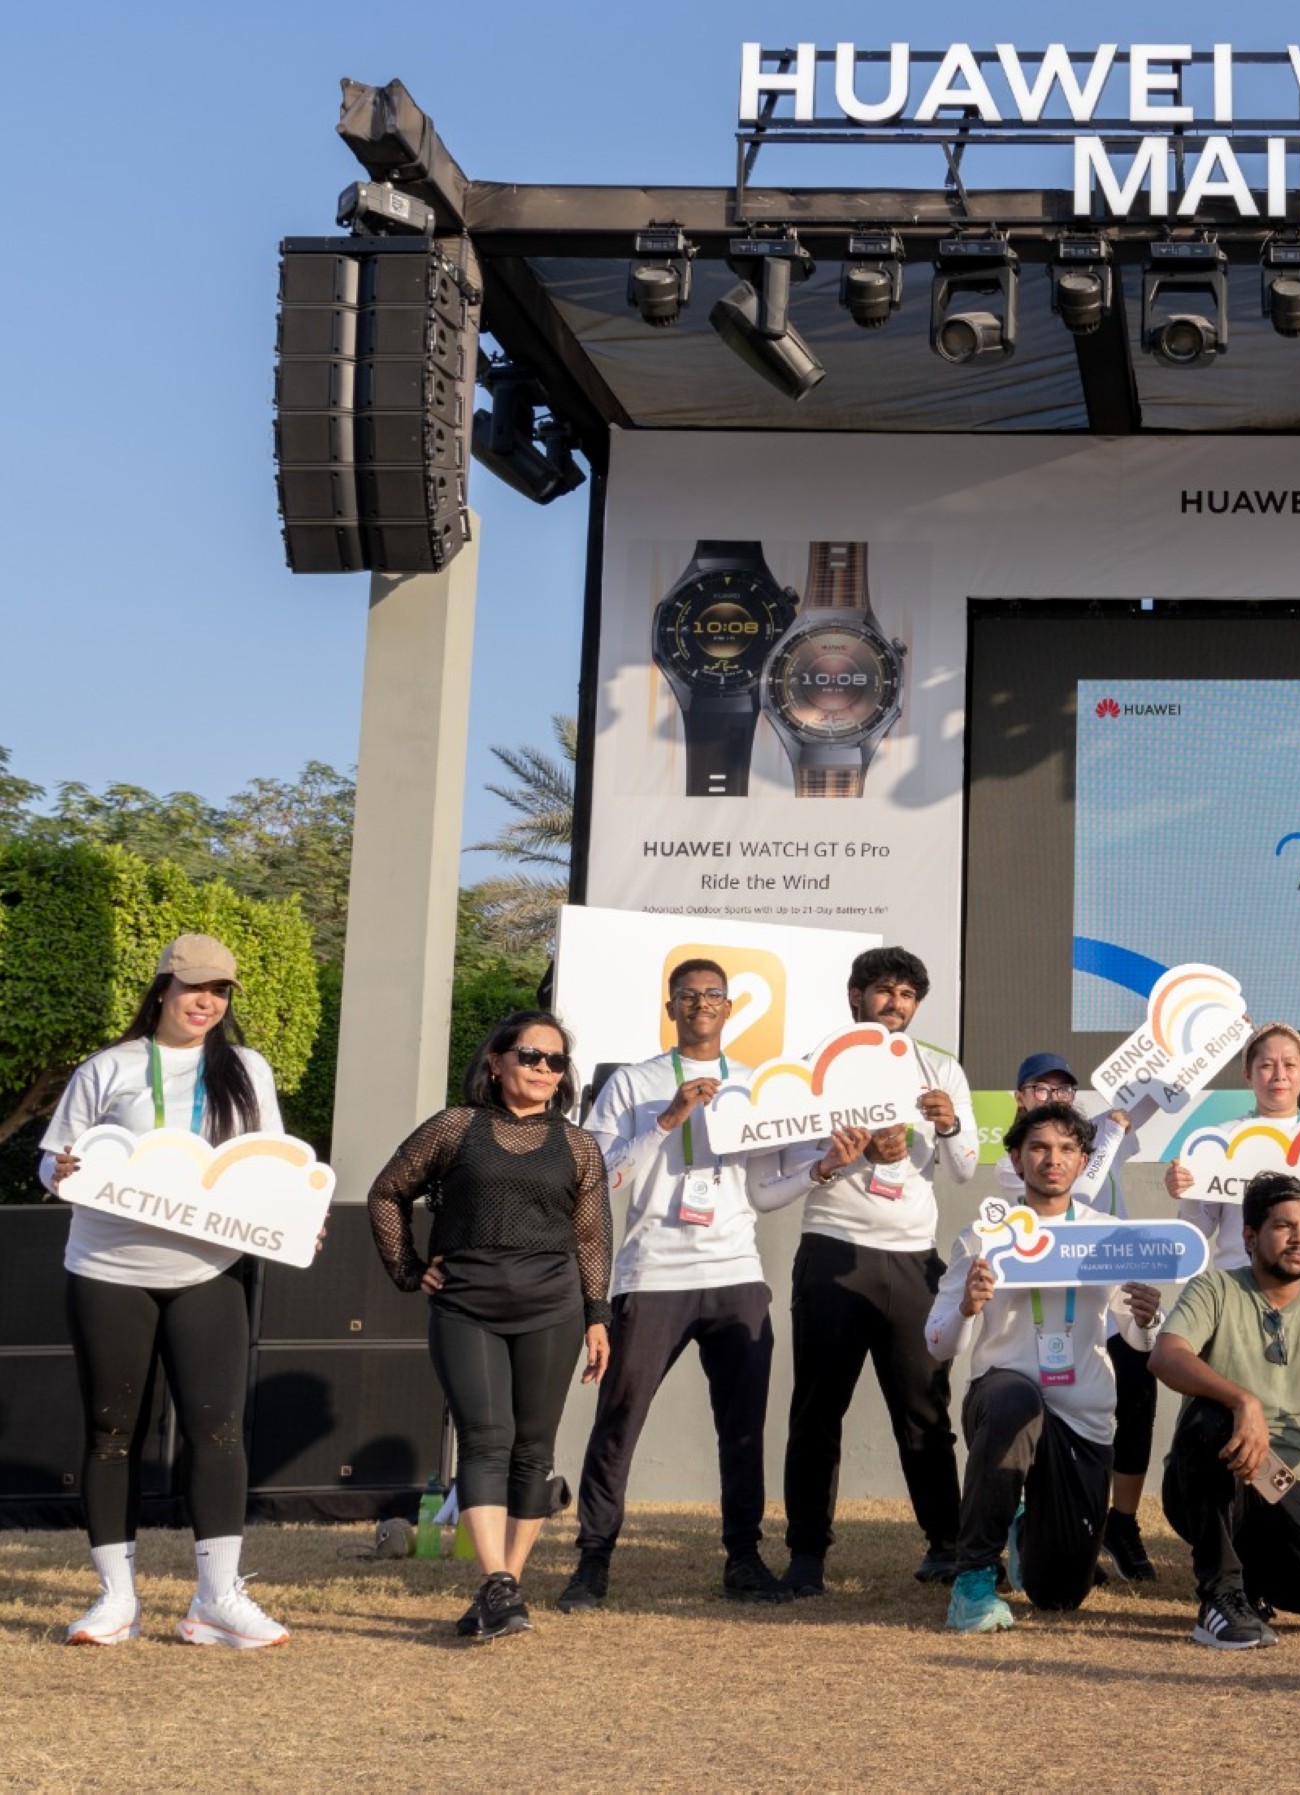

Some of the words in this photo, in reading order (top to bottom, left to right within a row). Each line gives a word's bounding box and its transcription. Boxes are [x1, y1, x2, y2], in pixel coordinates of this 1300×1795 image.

[739, 42, 1232, 125] HUAWEI
[693, 622, 759, 634] 10:08
[801, 673, 868, 685] 10:08
[1124, 704, 1181, 715] HUAWEI
[643, 841, 731, 857] HUAWEI
[740, 841, 809, 857] WATCH
[814, 841, 839, 857] GT
[844, 842, 856, 857] 6
[861, 843, 890, 857] Pro
[701, 874, 740, 890] Ride
[747, 874, 776, 890] the
[783, 874, 831, 890] Wind
[686, 905, 721, 914] Outdoor
[1204, 1019, 1244, 1058] Rings
[1100, 1034, 1154, 1088] BRING
[1116, 1081, 1135, 1104] IT
[1135, 1049, 1170, 1084] ON!
[741, 1113, 823, 1143] ACTIVE
[830, 1103, 897, 1131] RINGS
[1207, 1176, 1250, 1196] ACT
[95, 1181, 198, 1226] ACTIVE
[204, 1211, 284, 1251] RINGS
[1060, 1243, 1097, 1258] RIDE
[1102, 1243, 1134, 1257] THE
[1139, 1242, 1186, 1256] WIND
